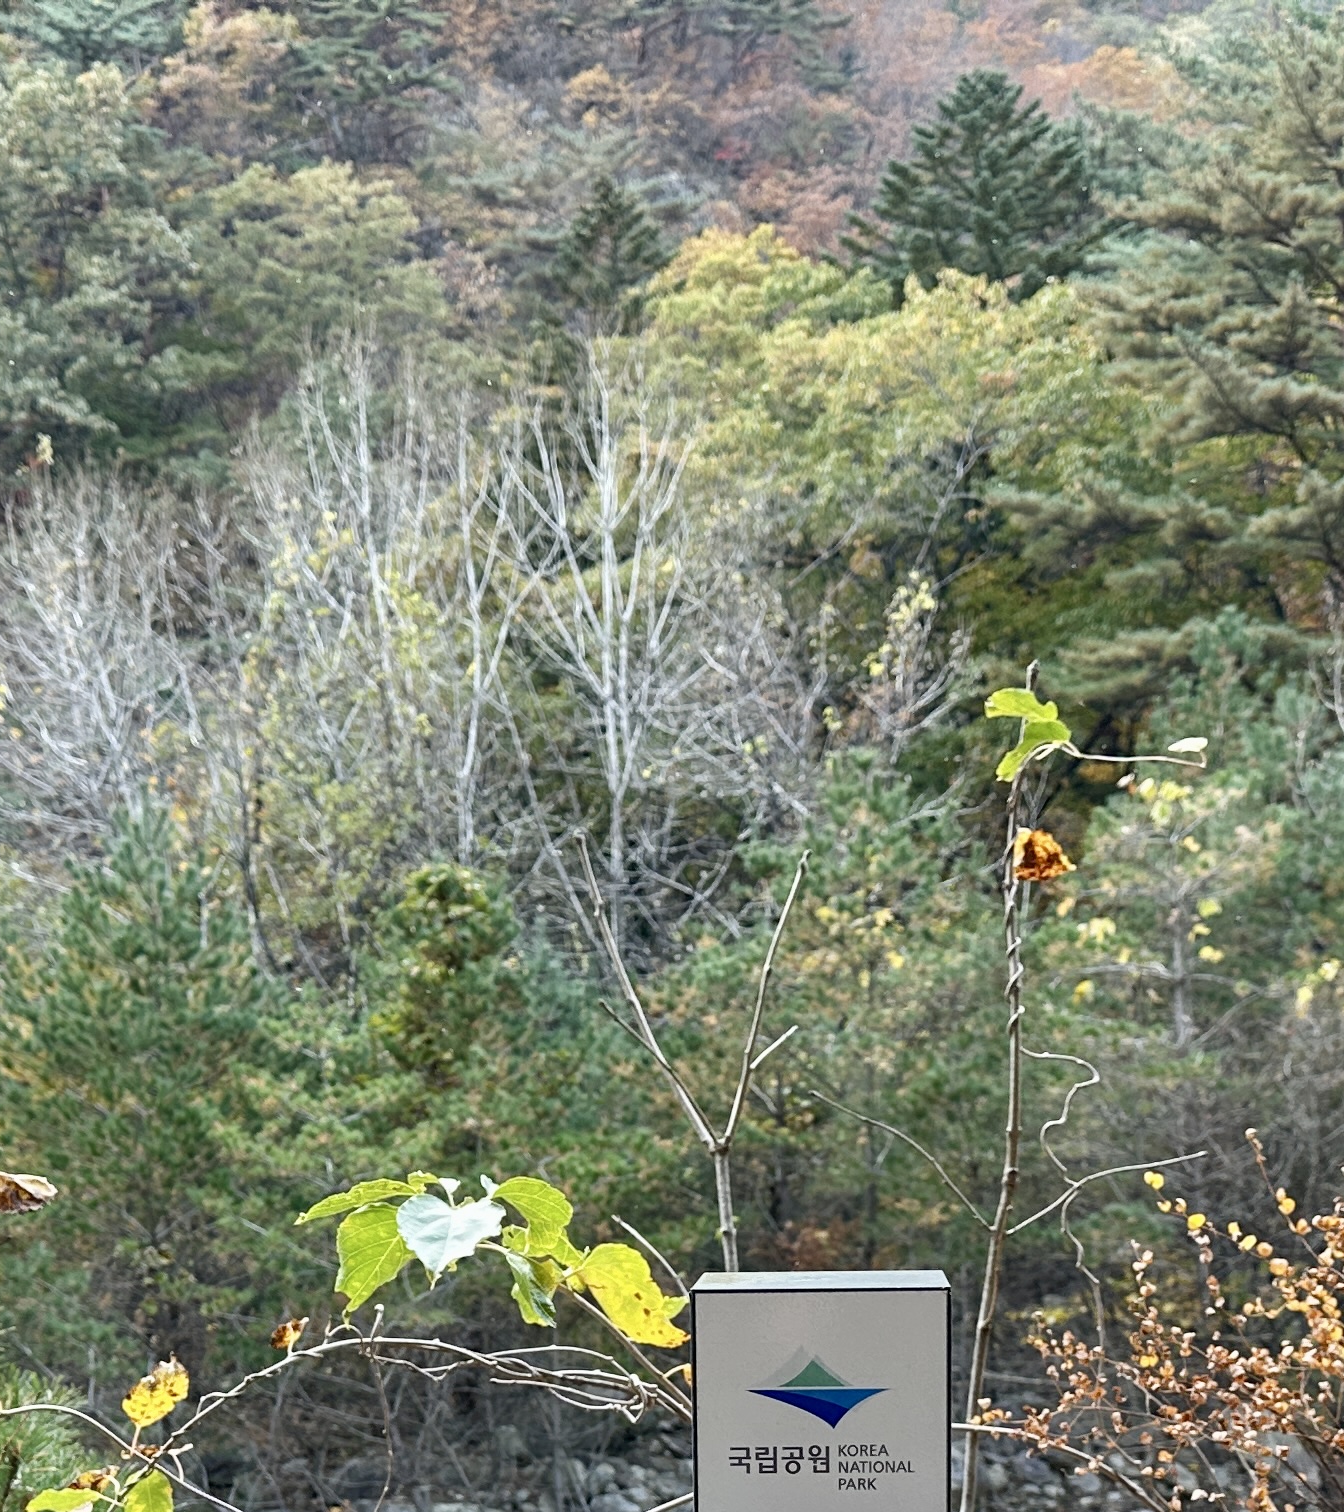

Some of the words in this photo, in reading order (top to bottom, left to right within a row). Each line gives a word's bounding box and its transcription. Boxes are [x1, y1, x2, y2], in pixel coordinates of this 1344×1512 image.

[838, 1444, 889, 1457] KOREA
[729, 1444, 830, 1475] 국립공원
[838, 1460, 915, 1473] NATIONAL
[838, 1478, 877, 1490] PARK
